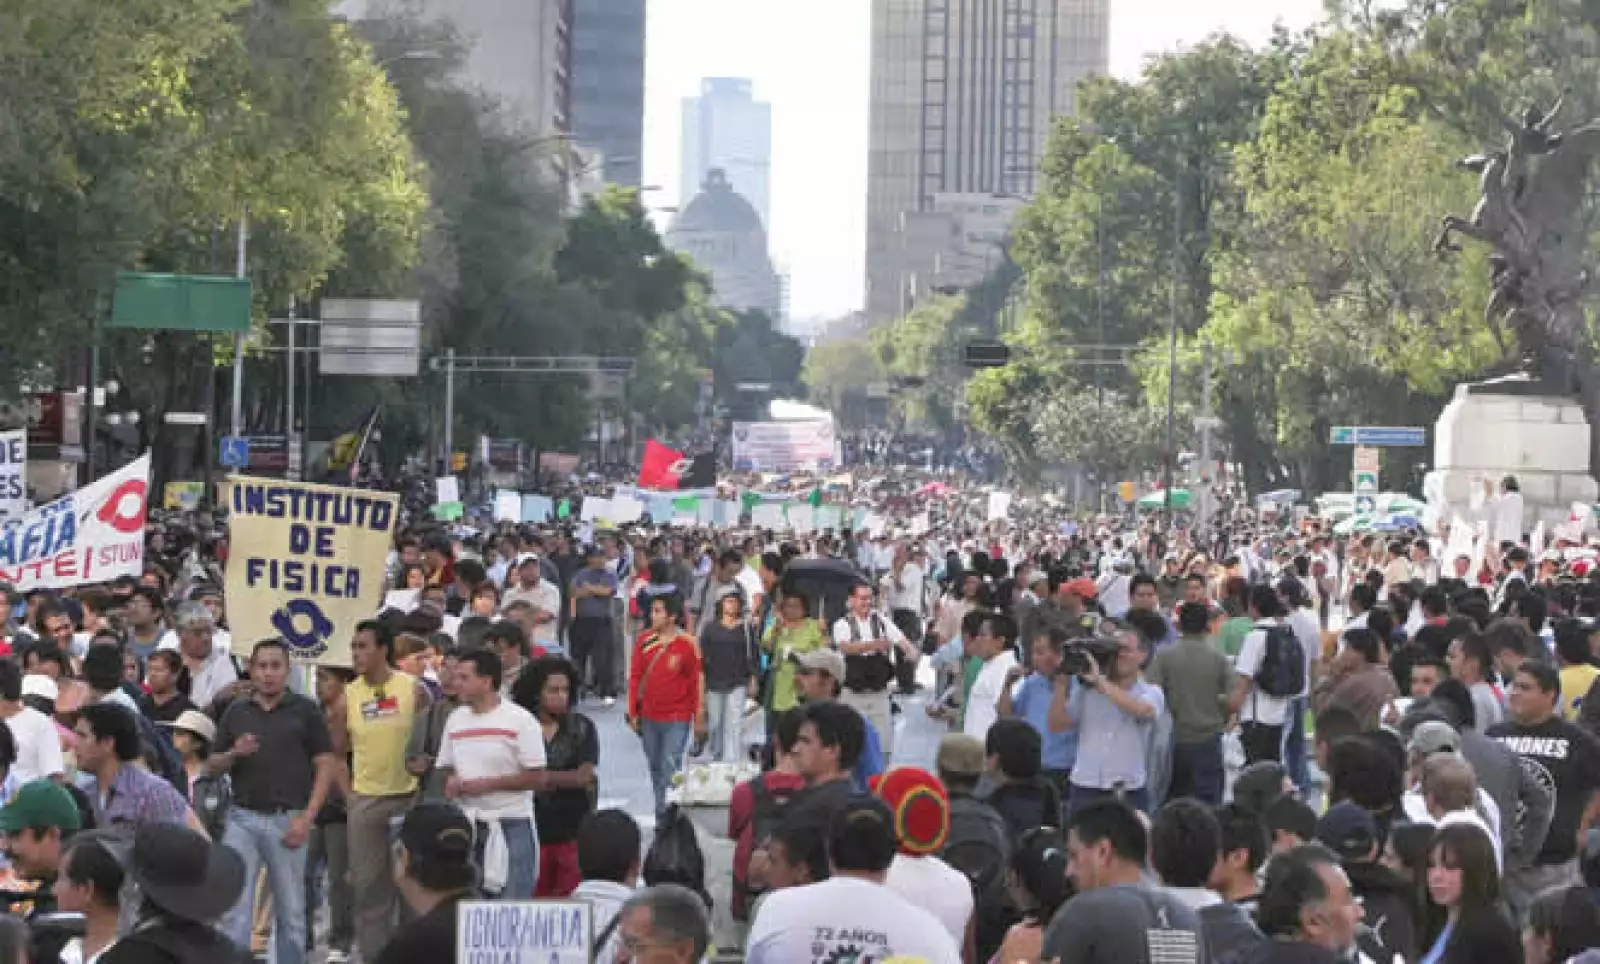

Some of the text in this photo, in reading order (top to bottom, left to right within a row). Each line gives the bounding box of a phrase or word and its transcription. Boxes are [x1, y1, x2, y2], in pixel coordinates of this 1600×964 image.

[233, 484, 391, 531] INSTITUTO
[289, 523, 336, 557] DE
[247, 558, 360, 599] FISICA
[1496, 736, 1570, 758] MONES
[464, 906, 582, 948] IGNORANCIA
[816, 927, 834, 941] 72
